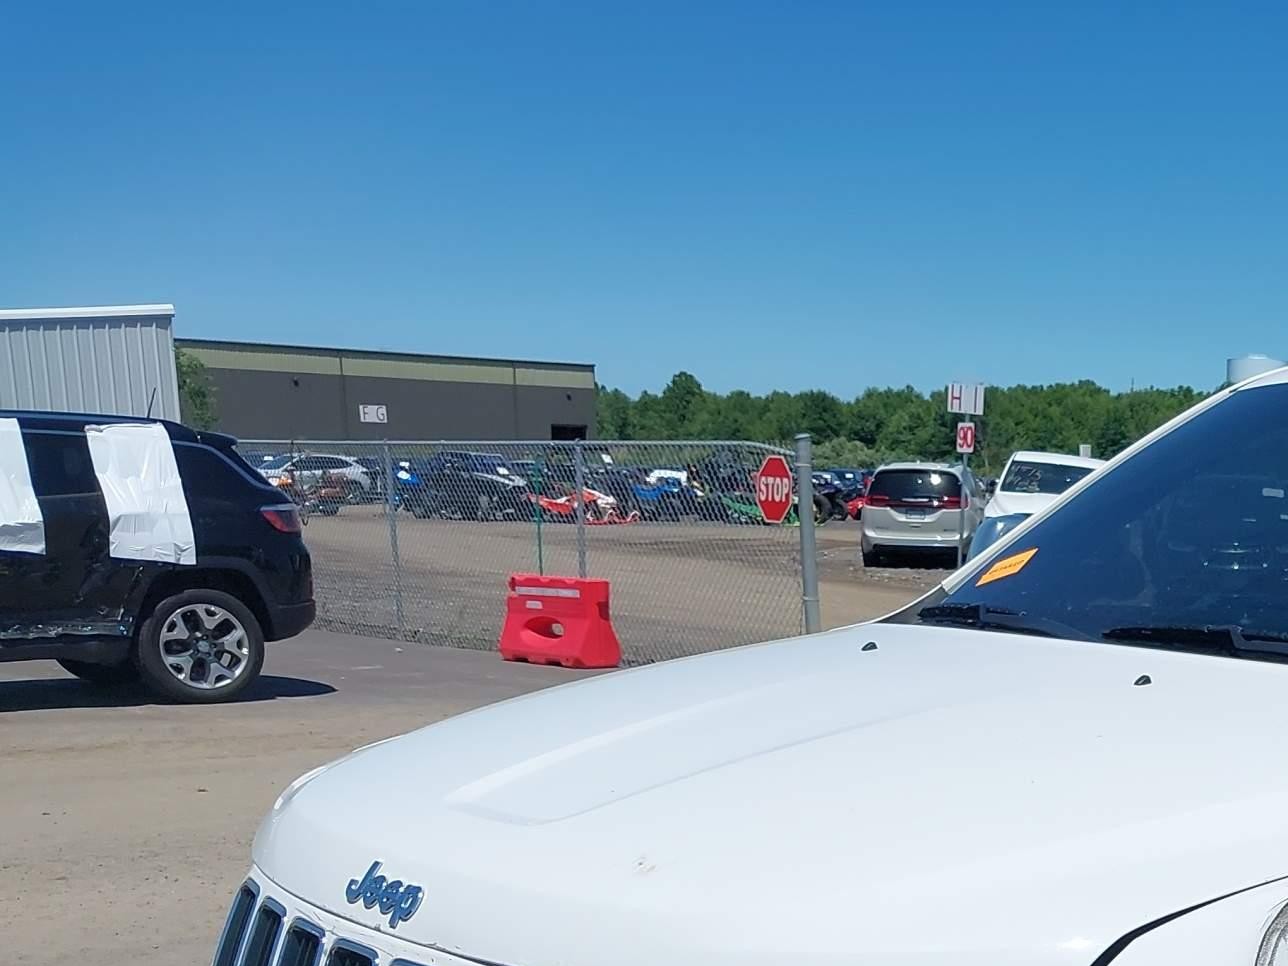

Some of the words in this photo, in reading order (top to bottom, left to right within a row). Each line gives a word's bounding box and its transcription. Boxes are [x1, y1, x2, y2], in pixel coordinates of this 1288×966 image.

[951, 384, 962, 411] H
[363, 406, 369, 421] F
[376, 406, 386, 421] G
[958, 426, 973, 448] 90
[760, 476, 789, 502] STOP
[345, 860, 424, 930] Jeep
